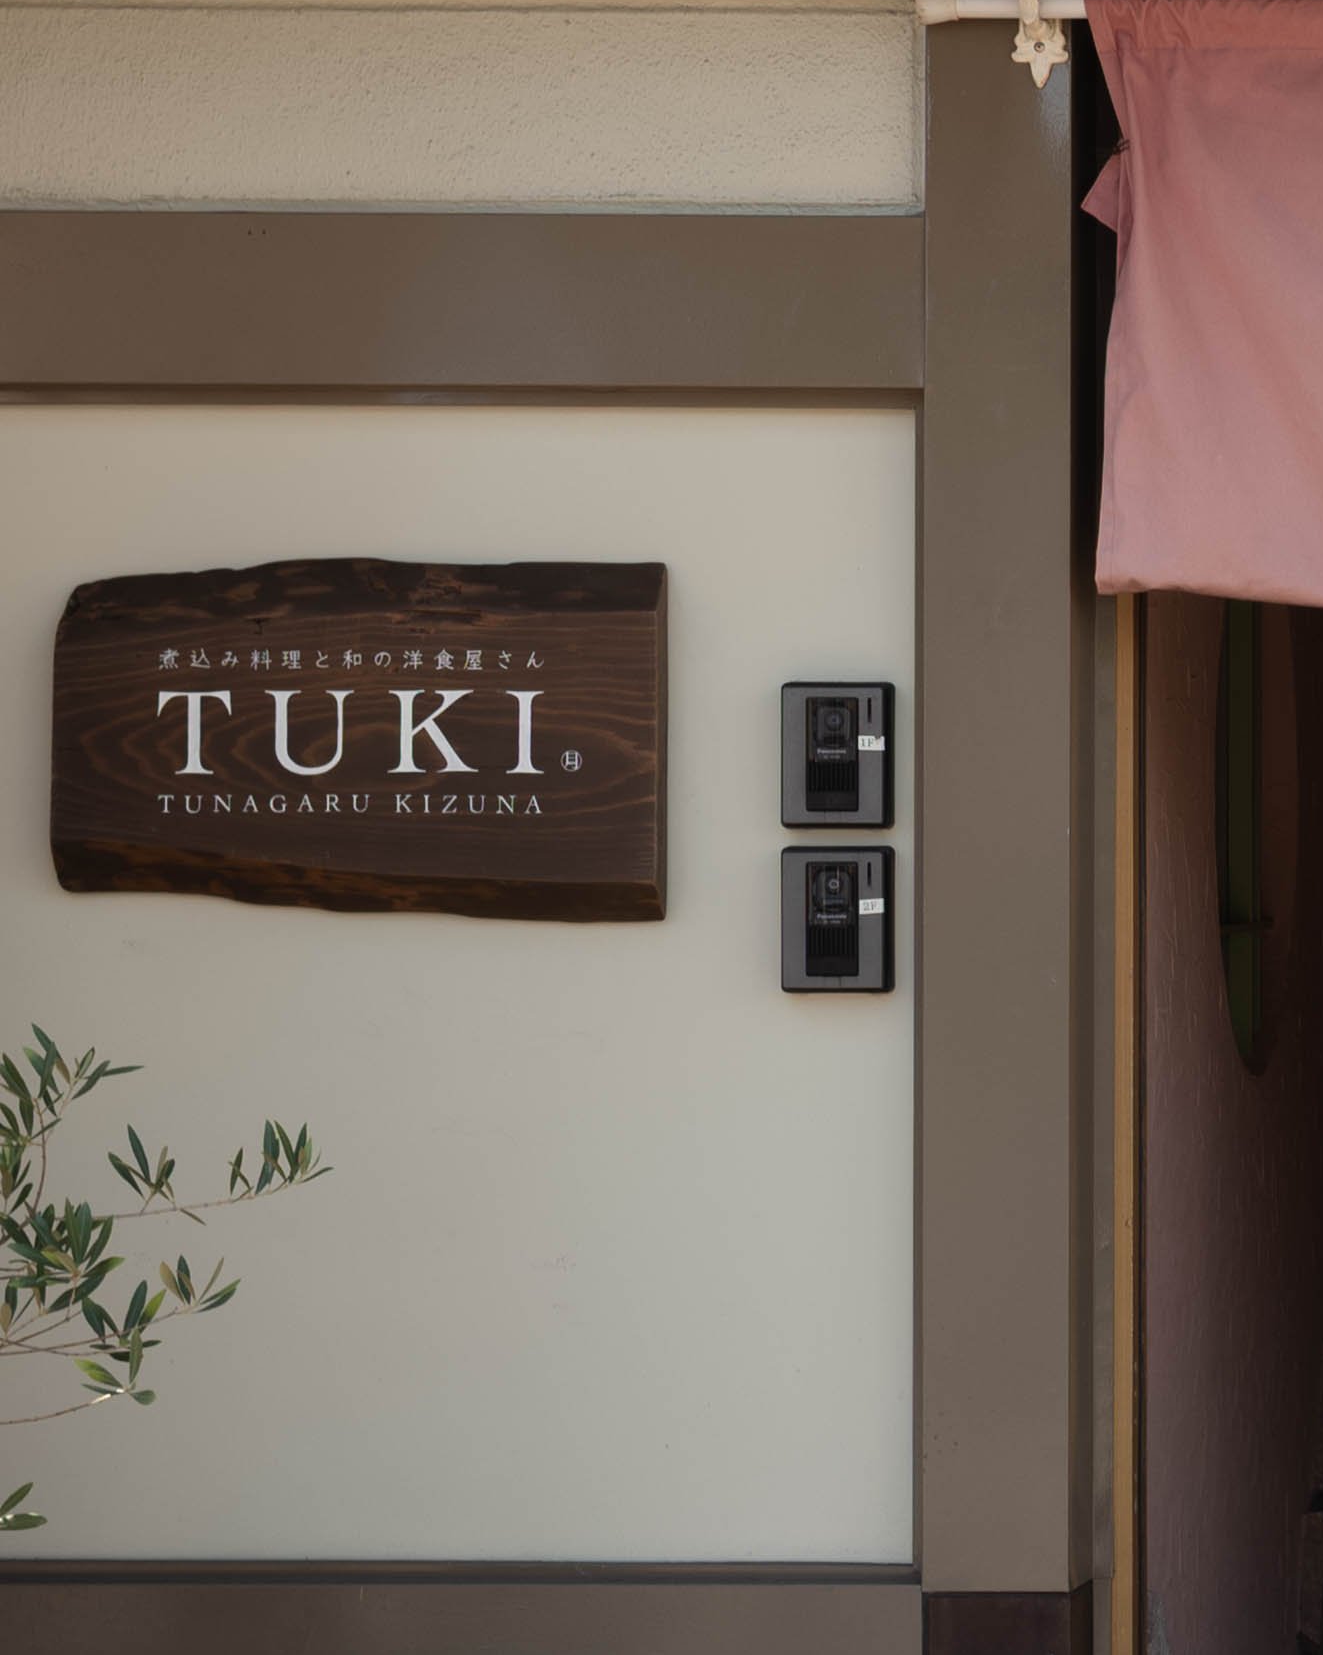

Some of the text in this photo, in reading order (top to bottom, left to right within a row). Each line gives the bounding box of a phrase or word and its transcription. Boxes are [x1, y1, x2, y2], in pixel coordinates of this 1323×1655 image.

[157, 648, 547, 672] 煮込み料理と和の洋食屋さん
[157, 689, 545, 776] TUKI
[157, 793, 544, 815] TUNAGARU KIZUNA
